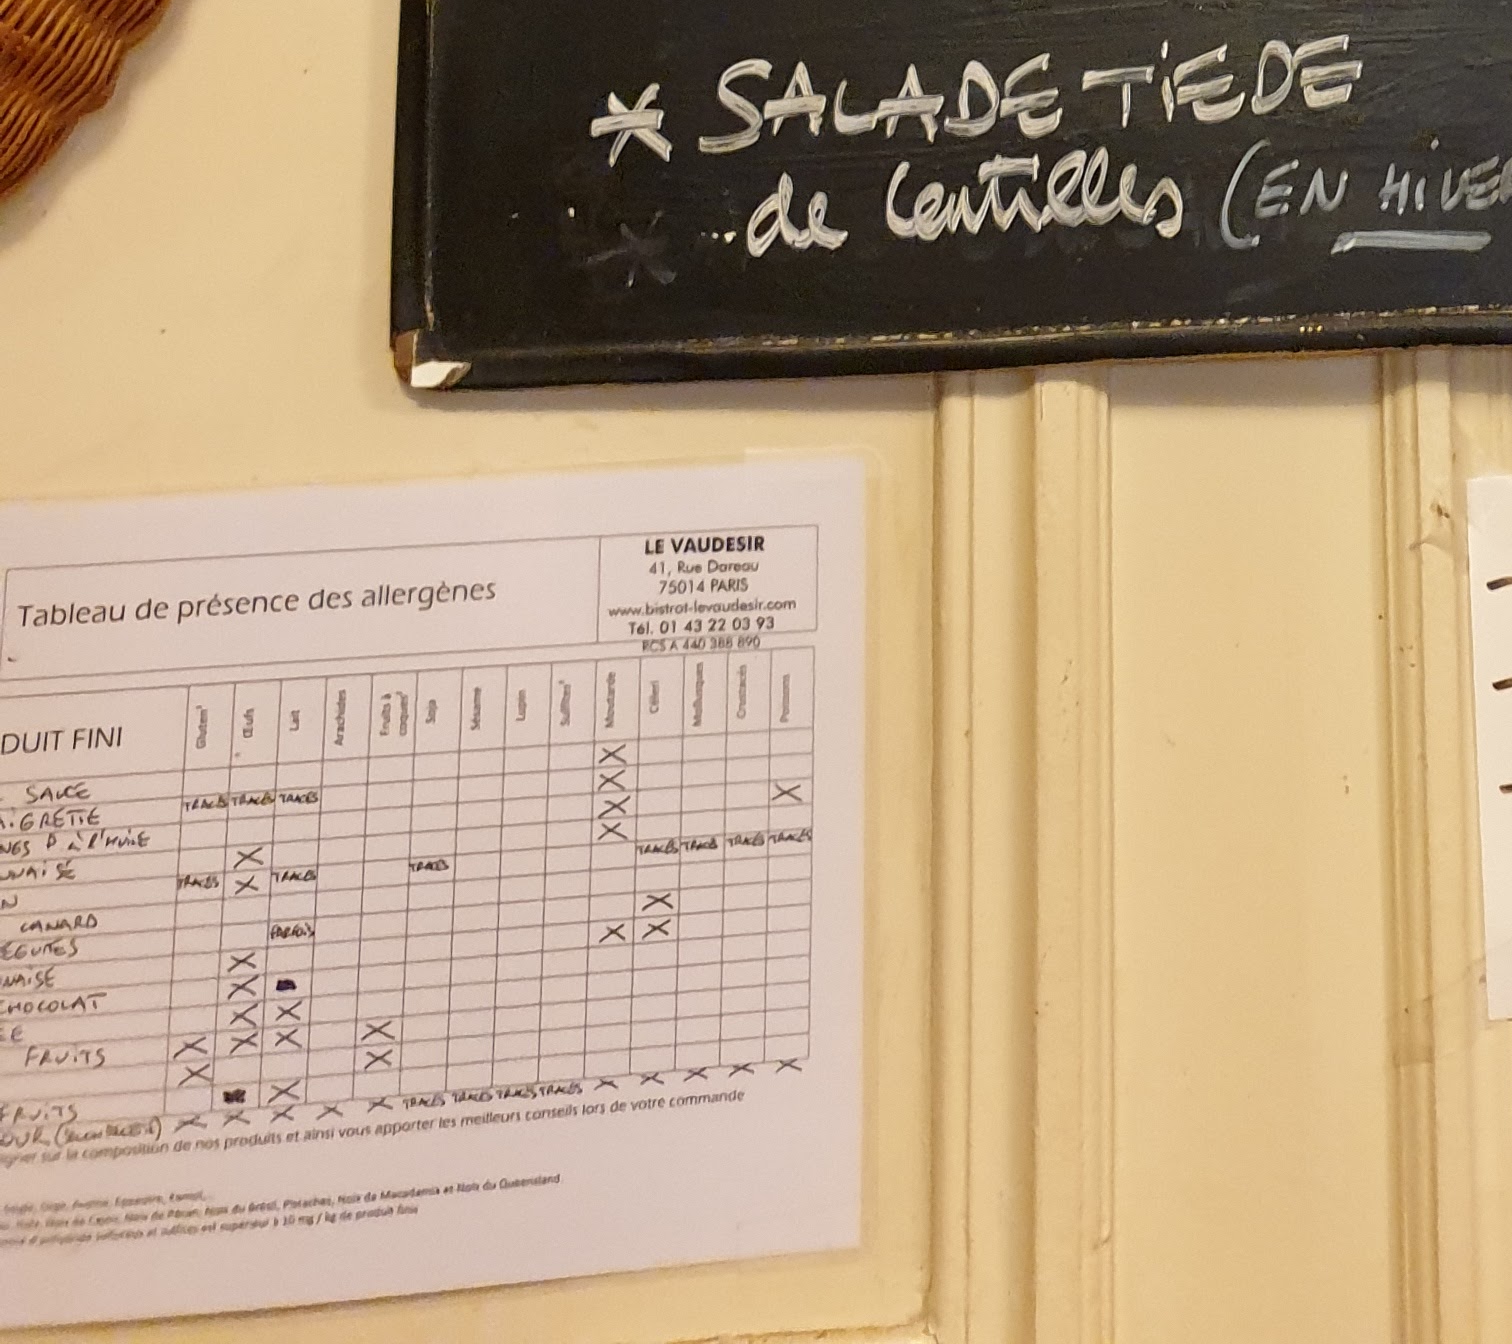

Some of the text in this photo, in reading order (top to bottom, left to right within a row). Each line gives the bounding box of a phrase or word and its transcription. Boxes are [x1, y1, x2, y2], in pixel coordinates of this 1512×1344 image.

[700, 54, 1065, 152] SALADE
[644, 536, 765, 555] LE VAUDESIR
[677, 561, 702, 574] Rue
[707, 560, 759, 573] Dareau
[659, 578, 749, 594] 75014 PARIS
[18, 577, 496, 629] Tableau de présence des allergènes
[659, 617, 775, 633] 01 43 22 03 93
[71, 726, 122, 750] FINI
[581, 1100, 606, 1116] lors
[609, 1099, 628, 1114] de
[631, 1095, 665, 1112] votre
[669, 1089, 746, 1109] commande
